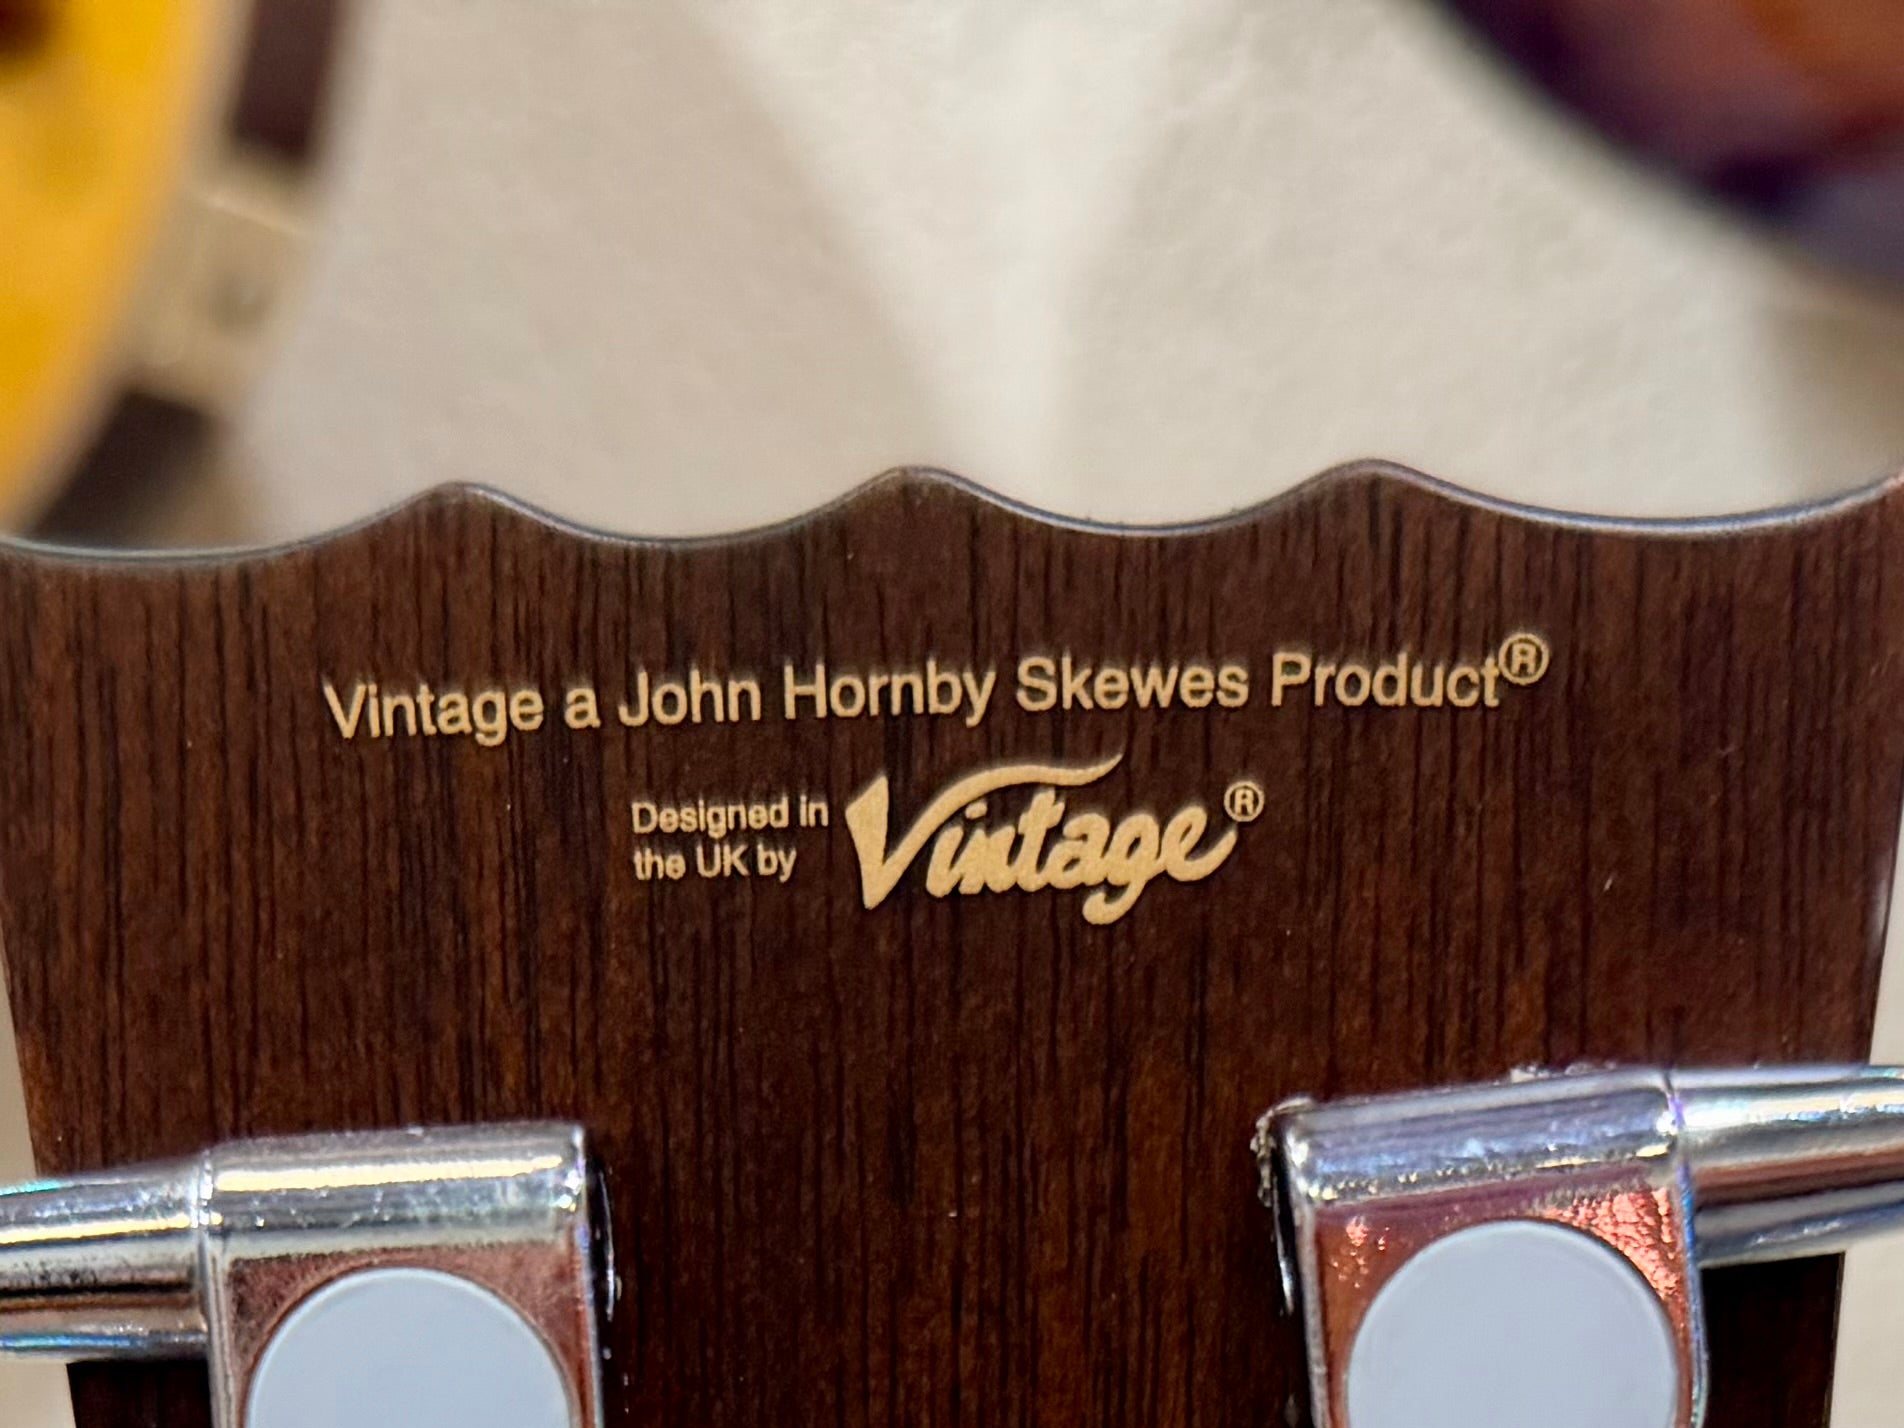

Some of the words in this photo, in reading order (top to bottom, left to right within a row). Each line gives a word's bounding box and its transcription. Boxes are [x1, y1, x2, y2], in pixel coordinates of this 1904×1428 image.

[322, 683, 545, 746] Vintage
[563, 686, 602, 729] a
[618, 668, 762, 726] John
[783, 659, 997, 727] Hornby
[1015, 652, 1250, 711] Skewes
[630, 795, 790, 840] Designed
[798, 794, 830, 828] in
[632, 846, 687, 881] the
[695, 843, 749, 879] UK
[756, 842, 798, 880] by
